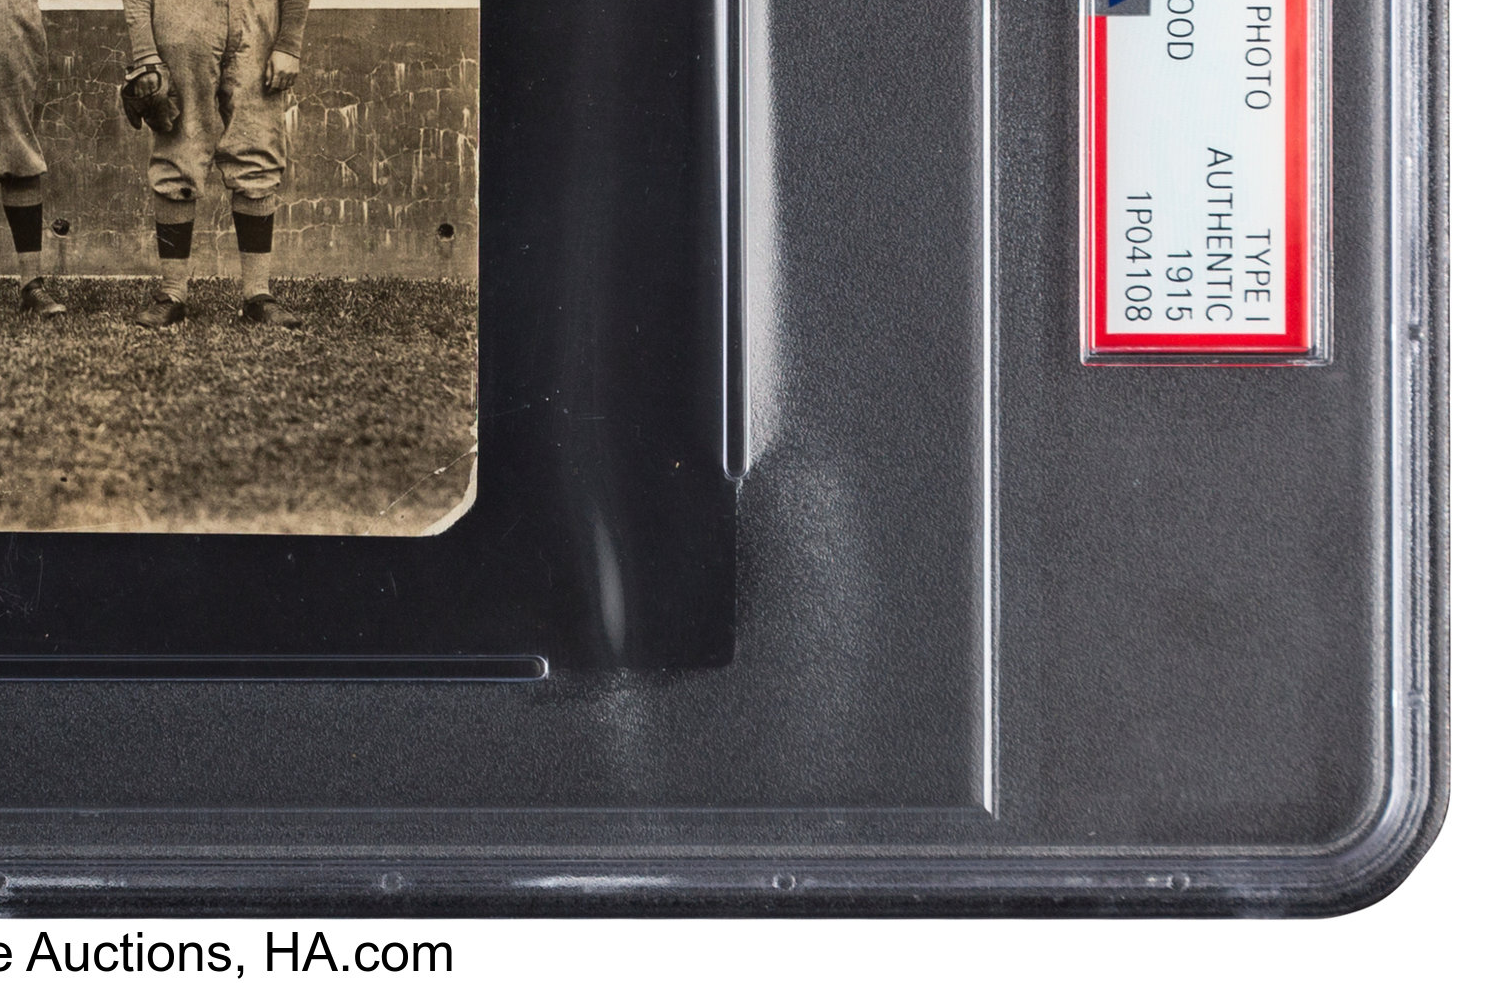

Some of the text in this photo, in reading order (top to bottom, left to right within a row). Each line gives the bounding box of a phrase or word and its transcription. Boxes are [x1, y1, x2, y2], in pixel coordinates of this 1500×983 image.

[1244, 6, 1272, 110] PHOTO
[1124, 191, 1153, 322] 1P04108
[1165, 249, 1193, 322] 1915
[1205, 146, 1233, 322] AUTHENTIC
[1244, 229, 1271, 303] TYPE
